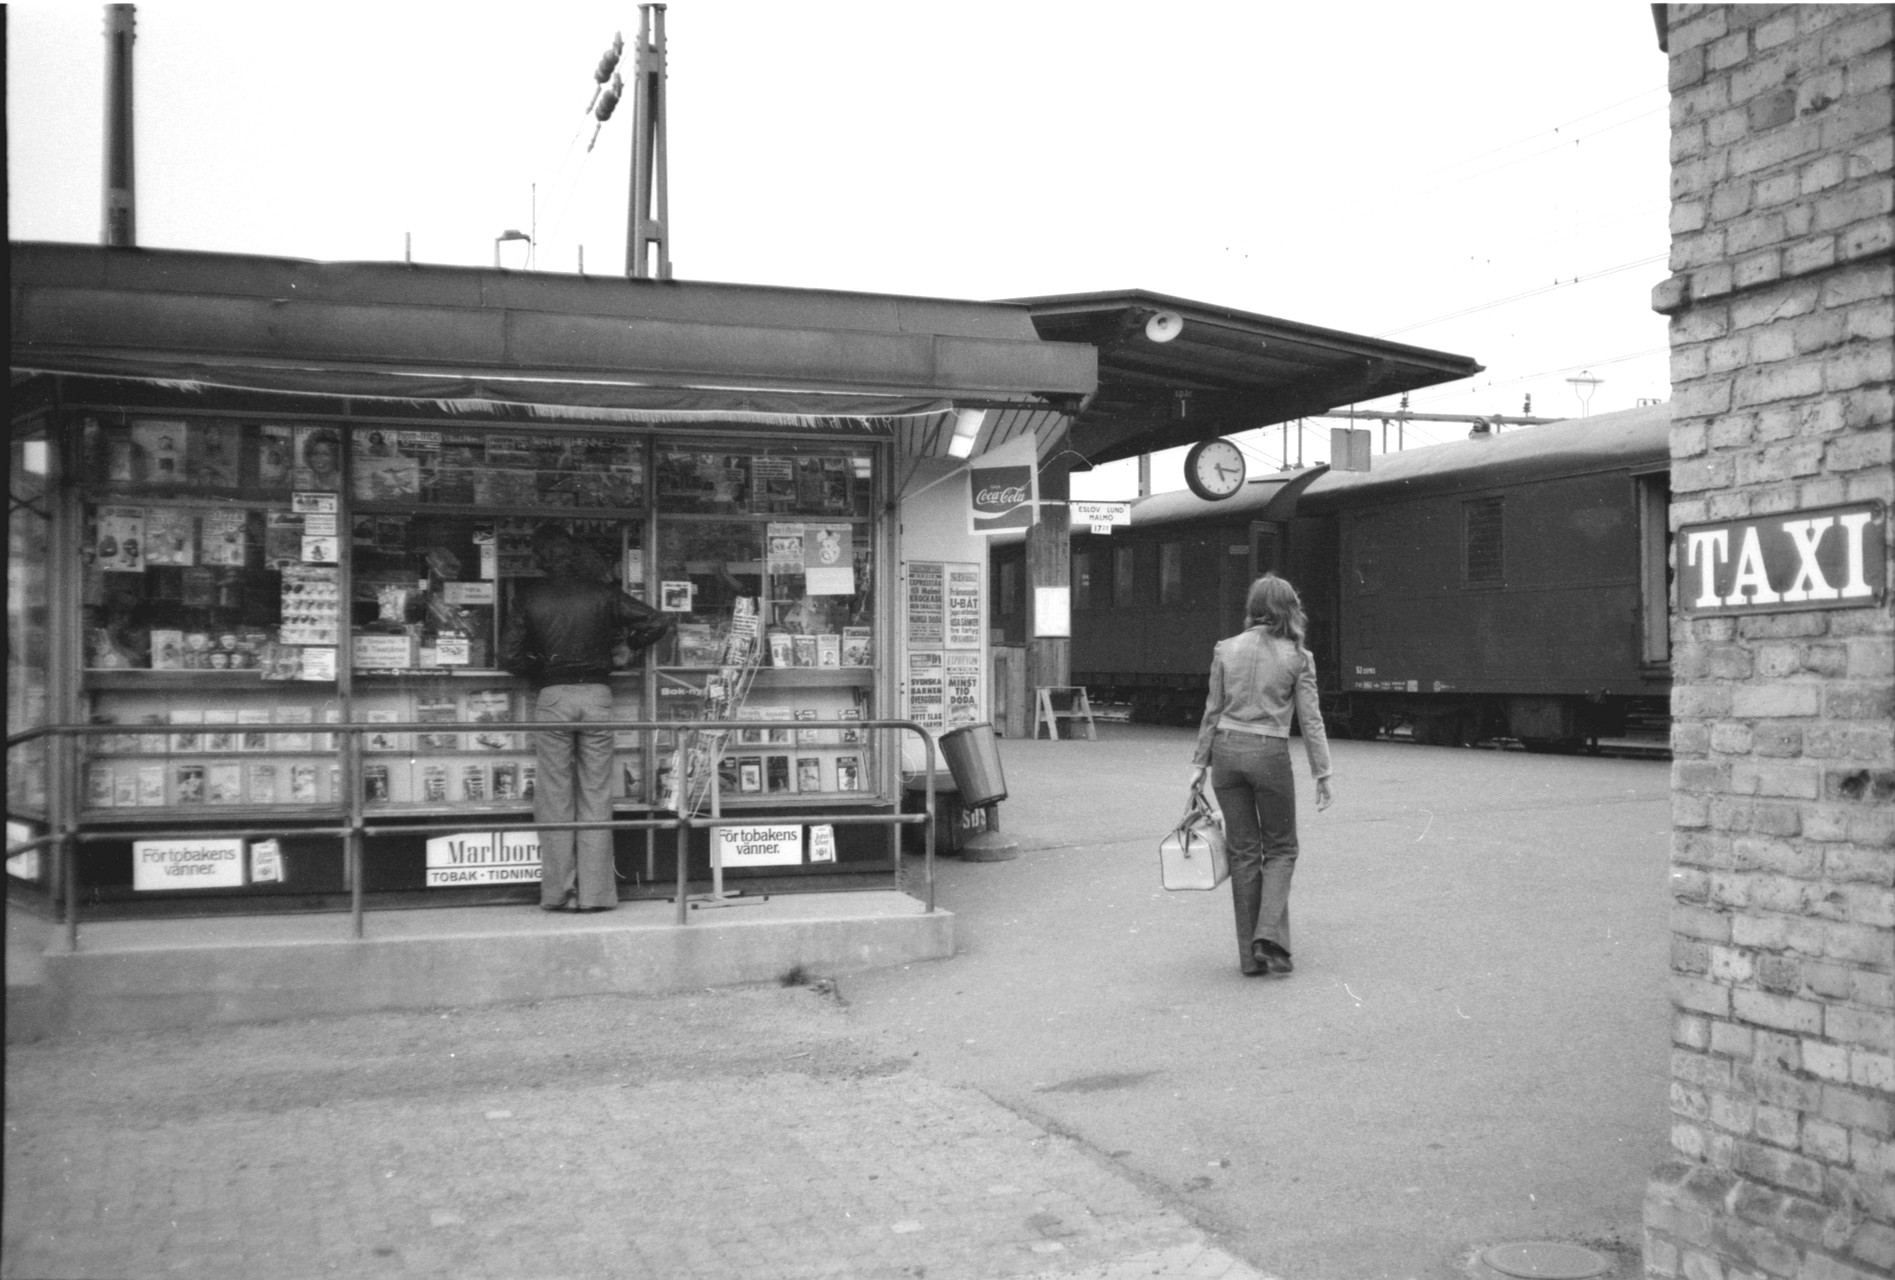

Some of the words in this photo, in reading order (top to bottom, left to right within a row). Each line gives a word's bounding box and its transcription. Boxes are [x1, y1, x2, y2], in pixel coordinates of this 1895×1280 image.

[976, 486, 1025, 505] Coca-Cola
[1107, 506, 1124, 514] LUND
[1688, 512, 1872, 607] TAXI
[950, 596, 978, 609] U-BÅT
[948, 679, 977, 687] MINST
[955, 687, 969, 696] TIO
[741, 828, 797, 842] tobakens
[142, 848, 166, 863] För
[169, 847, 236, 861] tobakens
[736, 842, 780, 855] vänner.
[164, 862, 216, 876] vänner.
[431, 871, 478, 882] TOBAK
